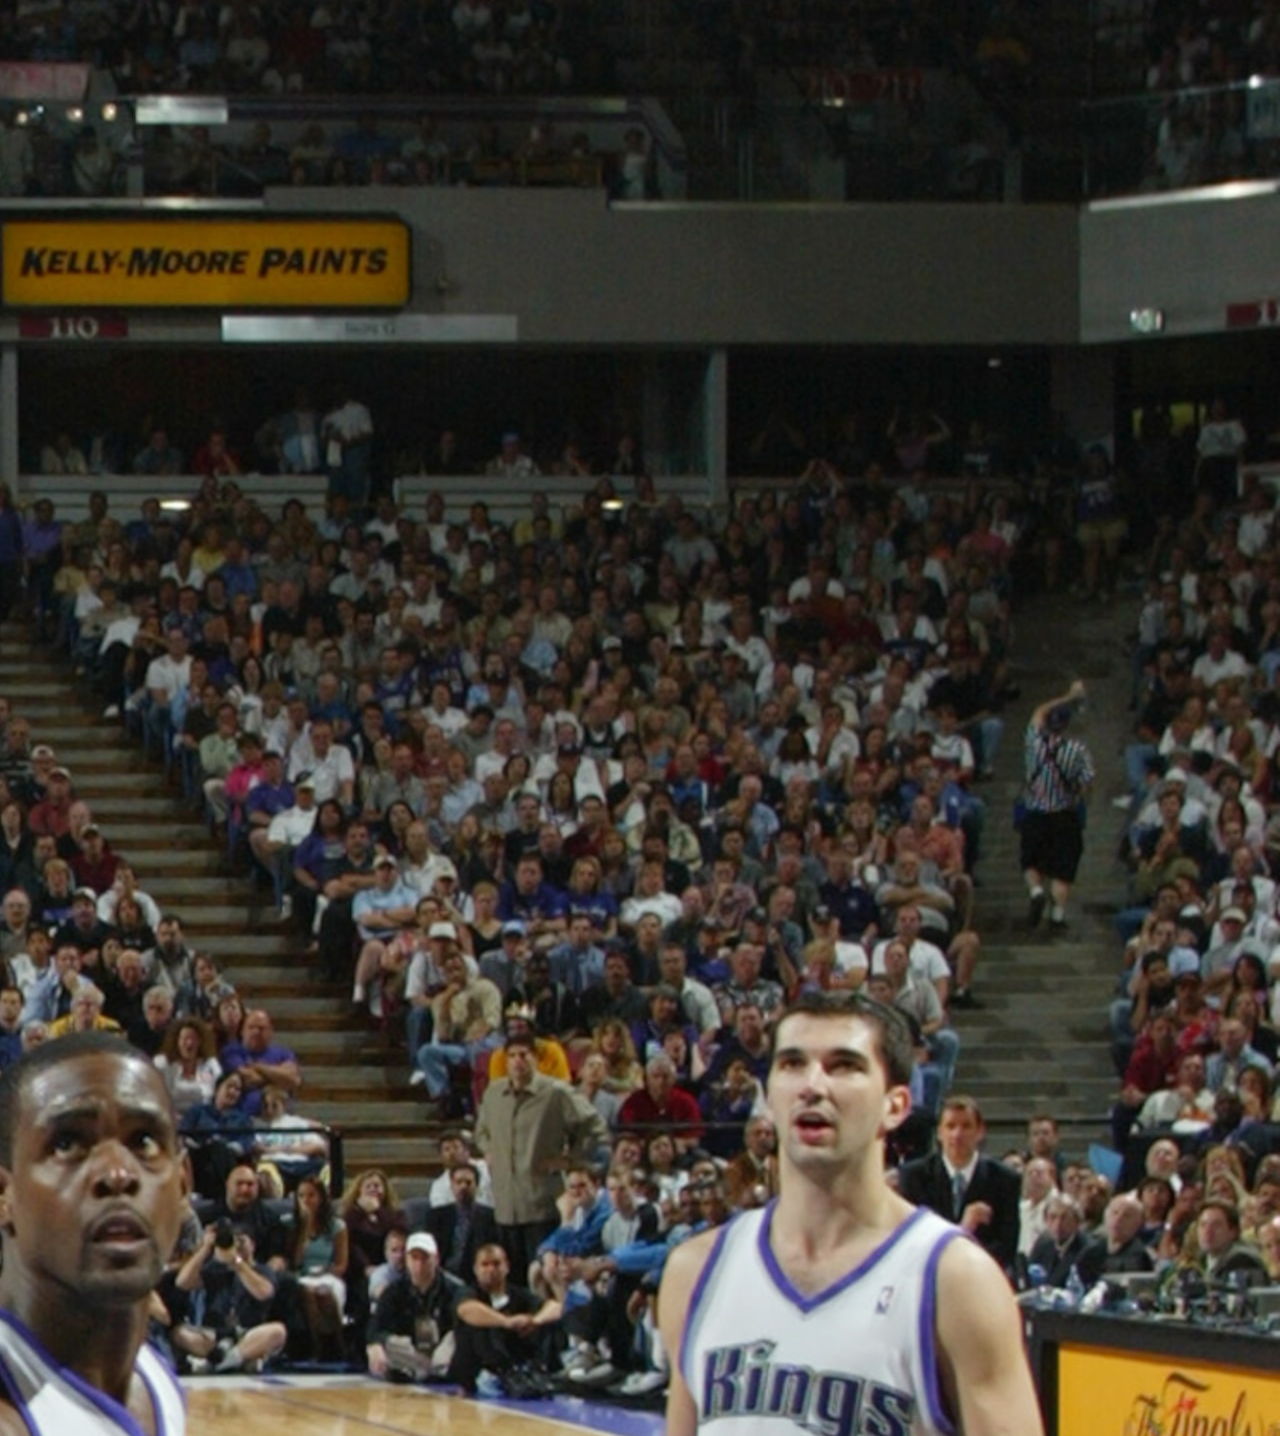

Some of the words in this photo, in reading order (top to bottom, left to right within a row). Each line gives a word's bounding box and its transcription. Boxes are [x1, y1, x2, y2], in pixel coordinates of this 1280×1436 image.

[20, 247, 249, 277] KELLY-MOORE
[258, 247, 388, 278] PAINTS
[50, 316, 99, 339] 110
